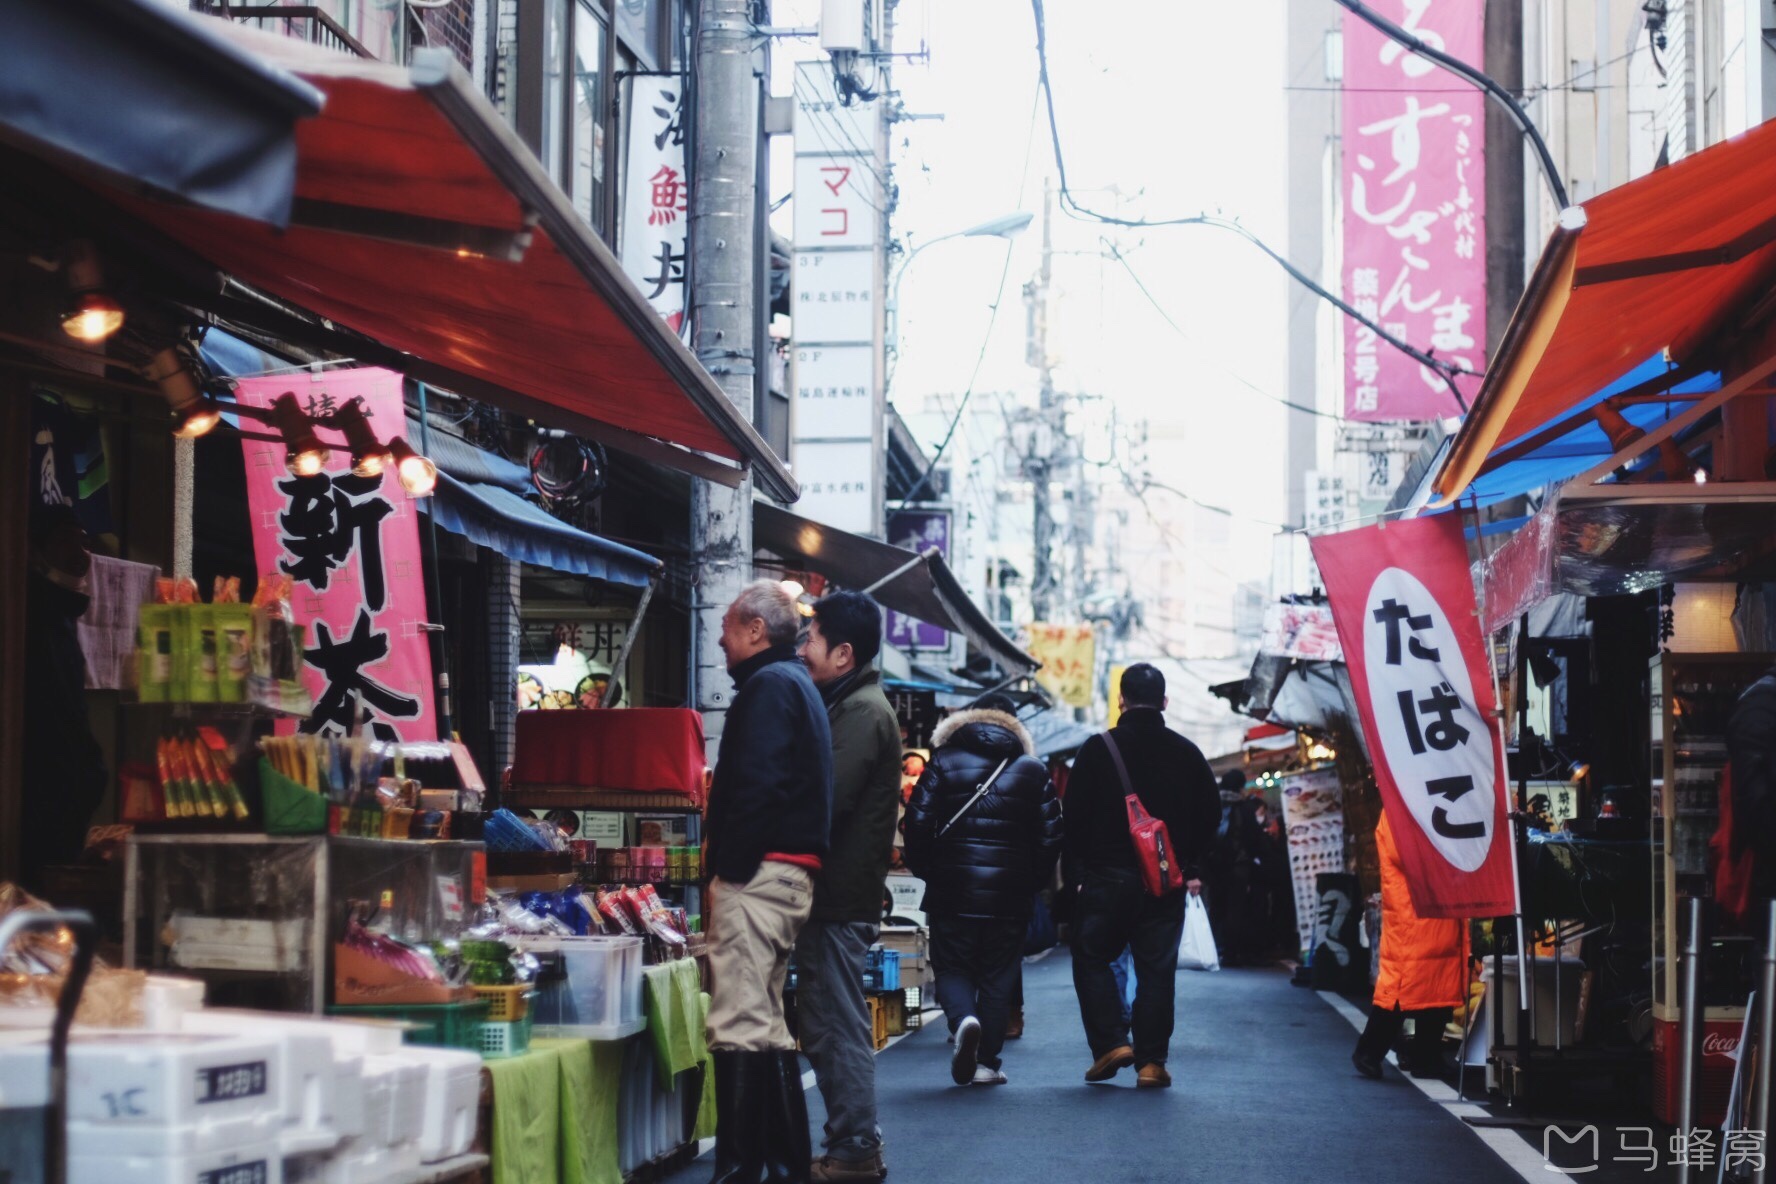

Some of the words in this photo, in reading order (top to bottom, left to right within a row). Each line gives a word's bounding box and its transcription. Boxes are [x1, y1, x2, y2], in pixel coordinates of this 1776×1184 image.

[819, 166, 851, 236] マコ
[1373, 598, 1487, 840] たばこ
